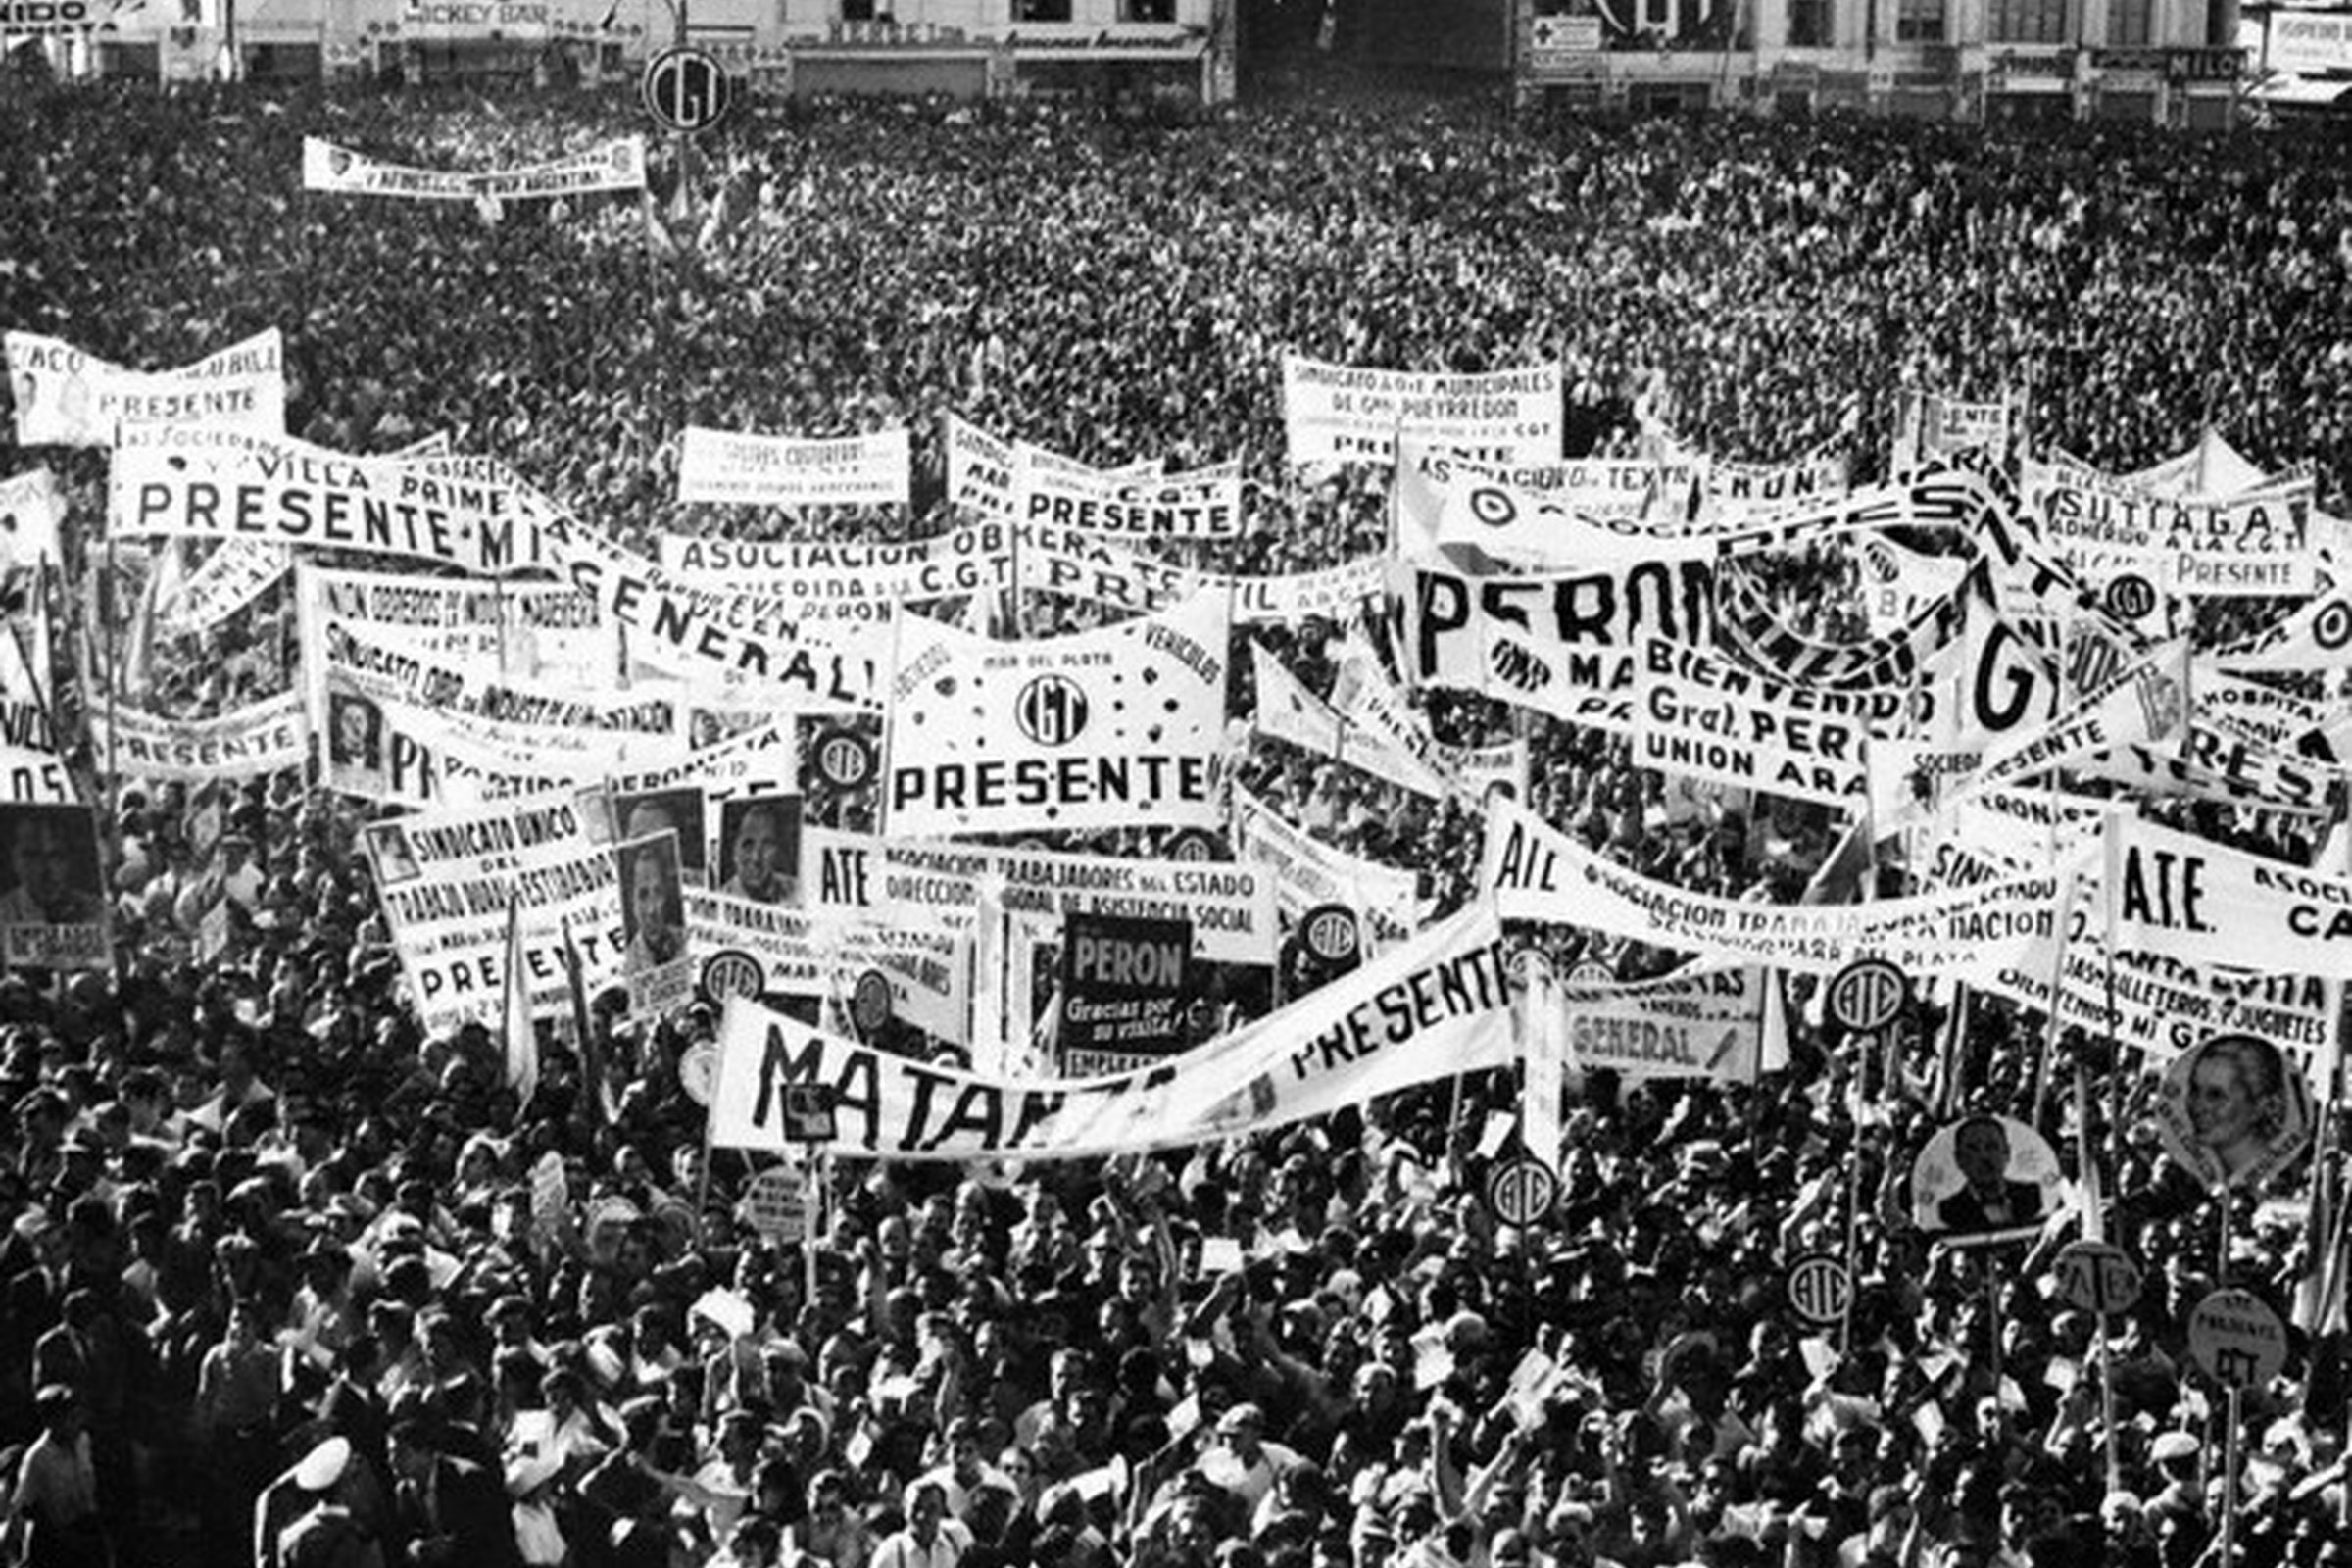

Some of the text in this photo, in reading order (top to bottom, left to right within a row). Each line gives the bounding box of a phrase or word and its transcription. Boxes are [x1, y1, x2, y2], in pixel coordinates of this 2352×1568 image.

[257, 455, 369, 491] VILLA
[139, 482, 454, 557] PRESENTE
[1029, 492, 1230, 535] PRESENTE
[682, 541, 929, 571] ASOCIACION
[2175, 552, 2292, 586] PRESENTE
[731, 594, 785, 618] EVA
[1647, 733, 1755, 777] UNION
[893, 755, 1206, 811] PRESENTE
[411, 816, 514, 863] SINDICATO
[479, 857, 522, 875] DEL
[820, 847, 870, 906] ATE
[997, 856, 1134, 892] TRABAJADORES
[1172, 871, 1256, 898] ESTADO
[886, 874, 977, 907] DIRECCION
[1194, 904, 1254, 934] SOCIAL
[1077, 937, 1183, 988] PERON
[1067, 998, 1140, 1024] Gracias
[1833, 964, 1902, 1027] ATE
[1495, 1162, 1554, 1224] ATE
